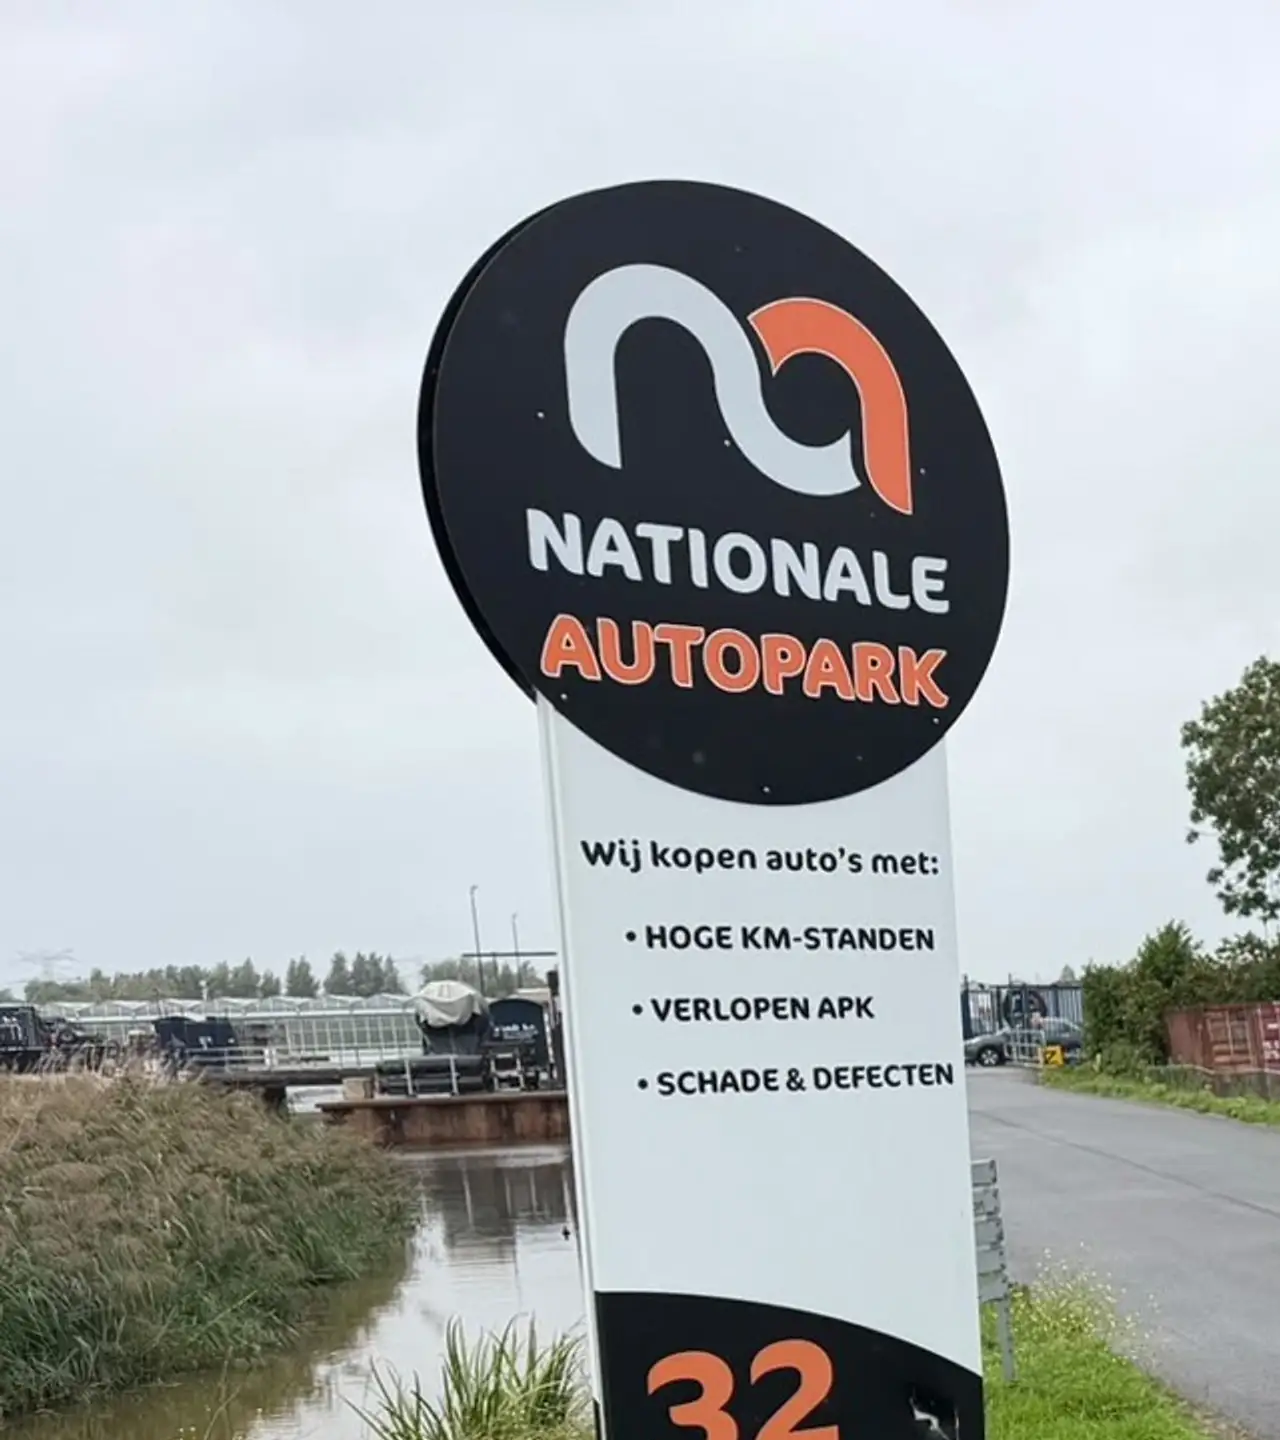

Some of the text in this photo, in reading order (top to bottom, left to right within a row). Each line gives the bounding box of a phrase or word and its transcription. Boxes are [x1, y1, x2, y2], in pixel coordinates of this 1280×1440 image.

[526, 508, 950, 614] NATIONALE
[540, 612, 950, 709] AUTOPARK
[580, 839, 641, 873] Wij
[650, 841, 757, 874] kopen
[871, 852, 940, 875] met:
[645, 926, 935, 951] HOGE KM-STANDEN
[650, 996, 875, 1021] VERLOPEN APK
[657, 1063, 954, 1096] SCHADE & DEFECTEN
